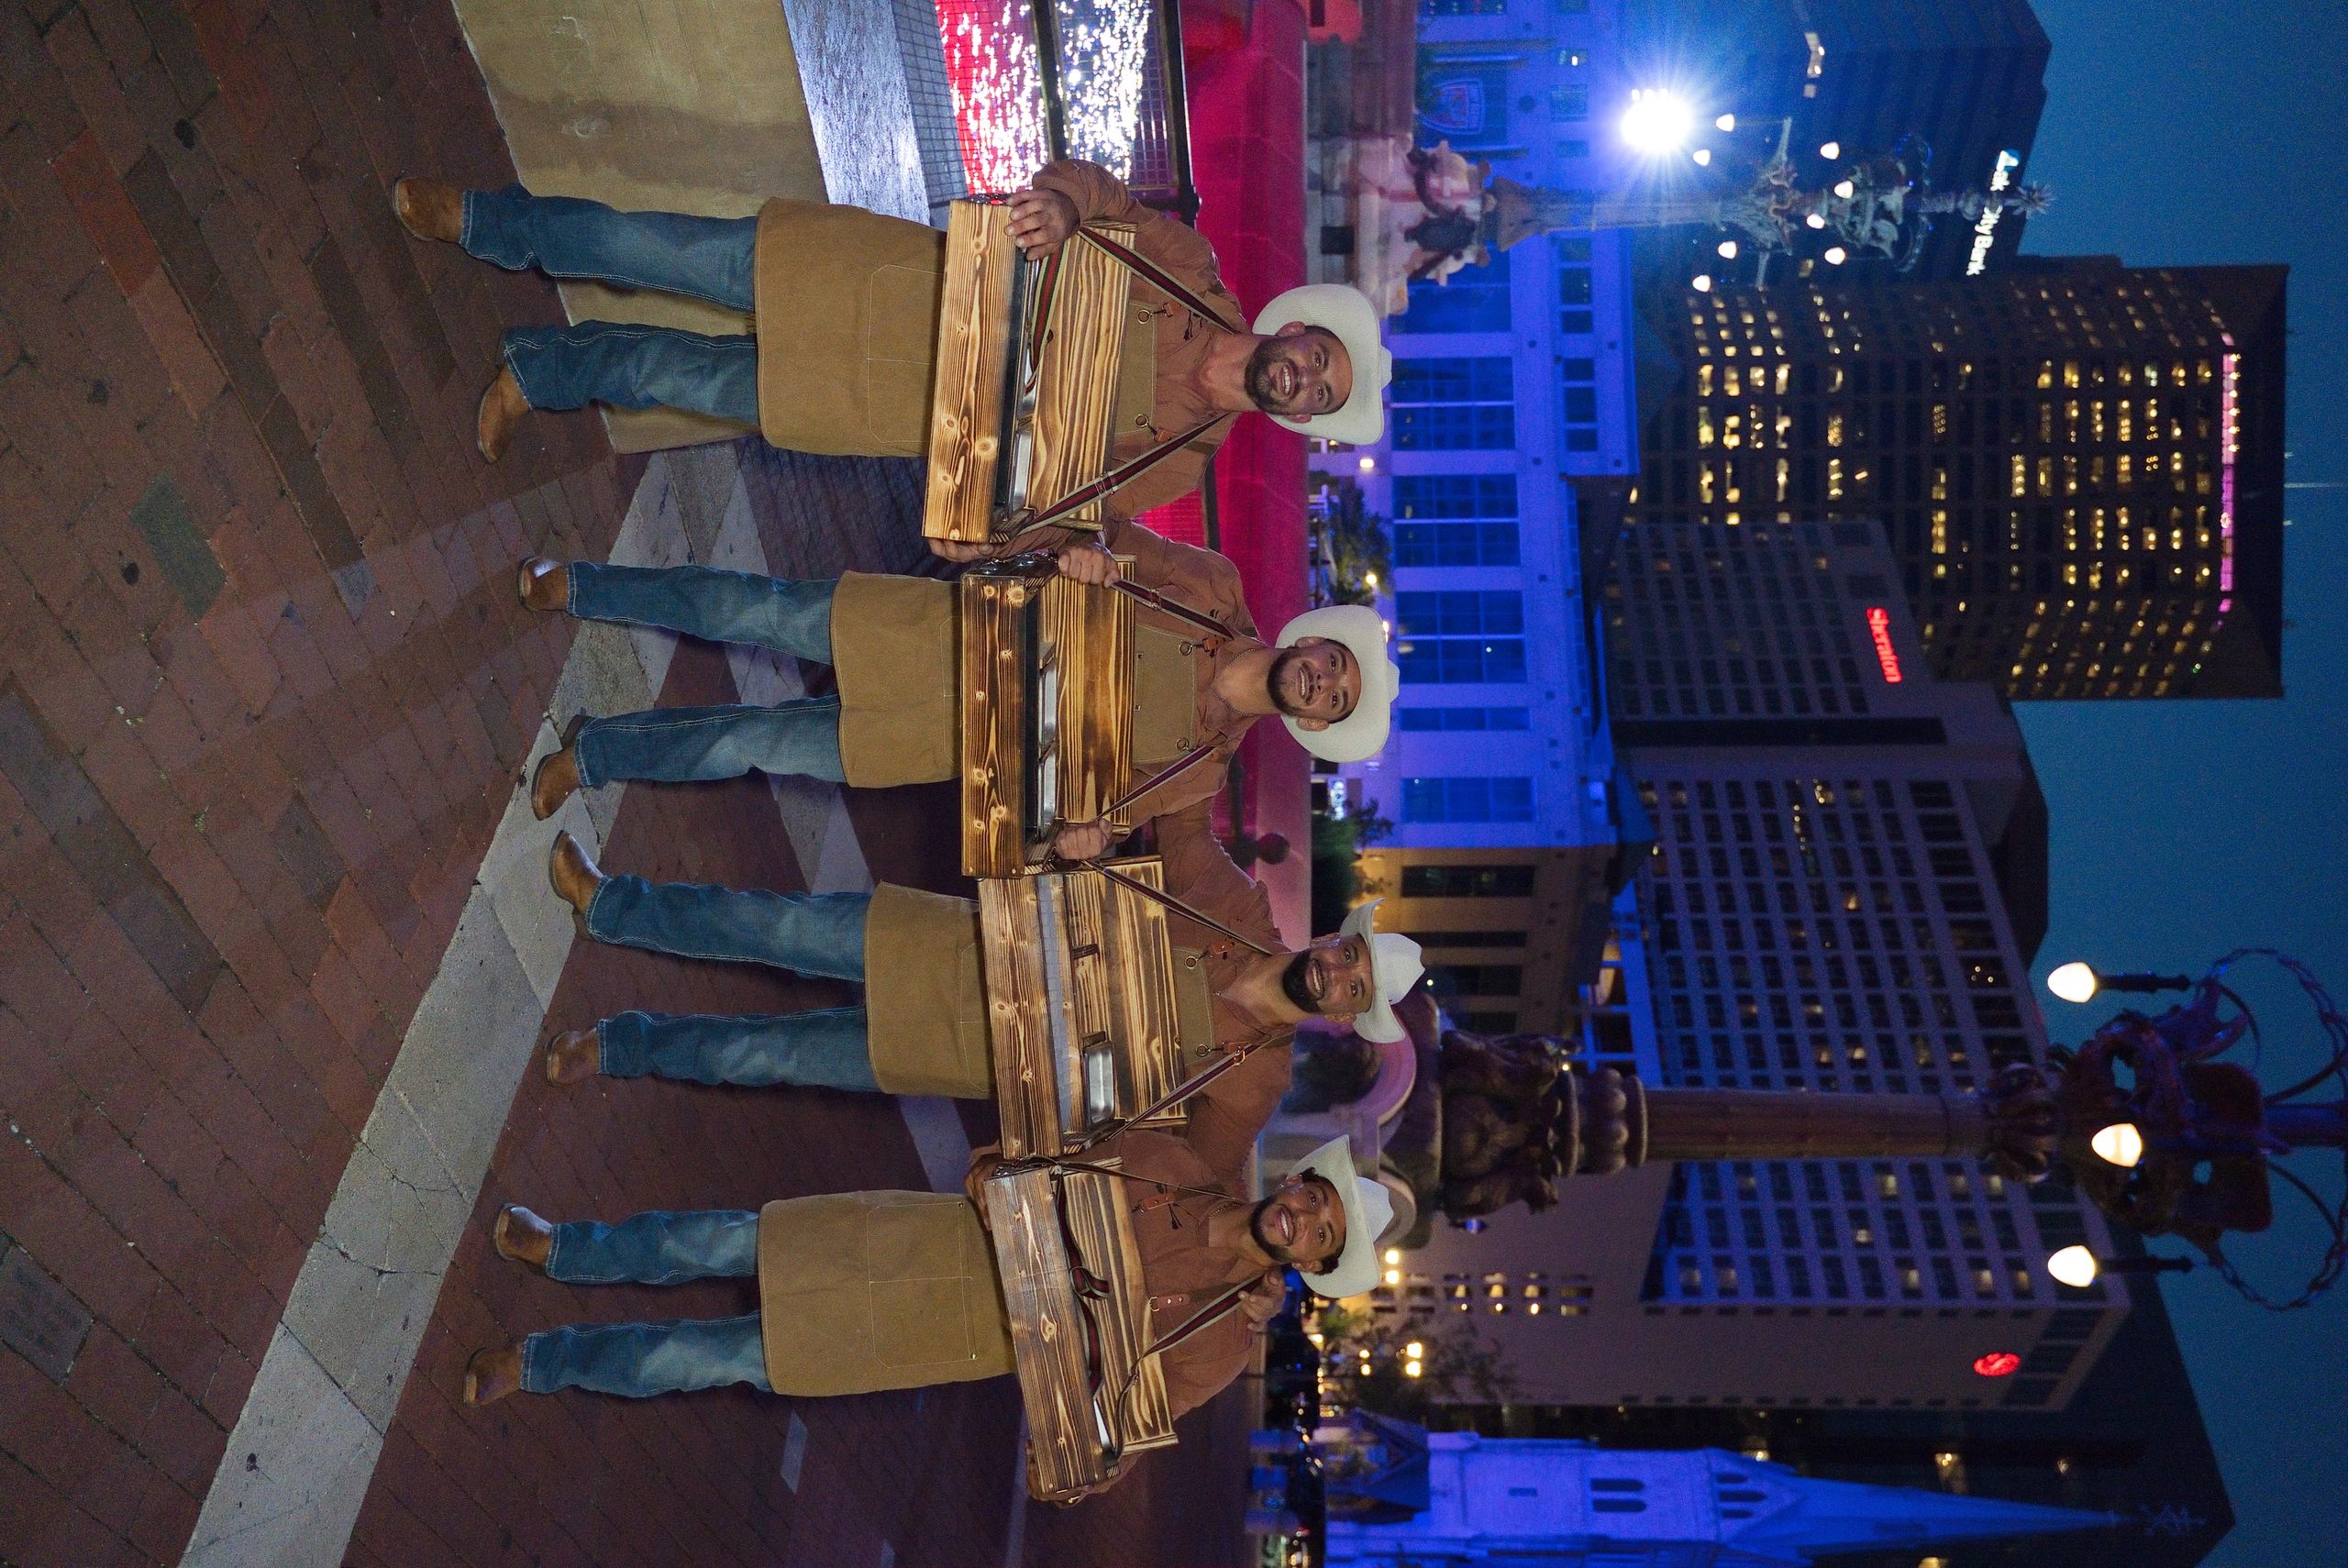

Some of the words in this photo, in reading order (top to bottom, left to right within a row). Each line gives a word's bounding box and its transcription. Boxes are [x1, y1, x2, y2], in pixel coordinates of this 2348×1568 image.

[1989, 150, 2019, 191] Lak
[1966, 235, 1994, 276] Bank
[1866, 608, 1902, 683] Sheraton
